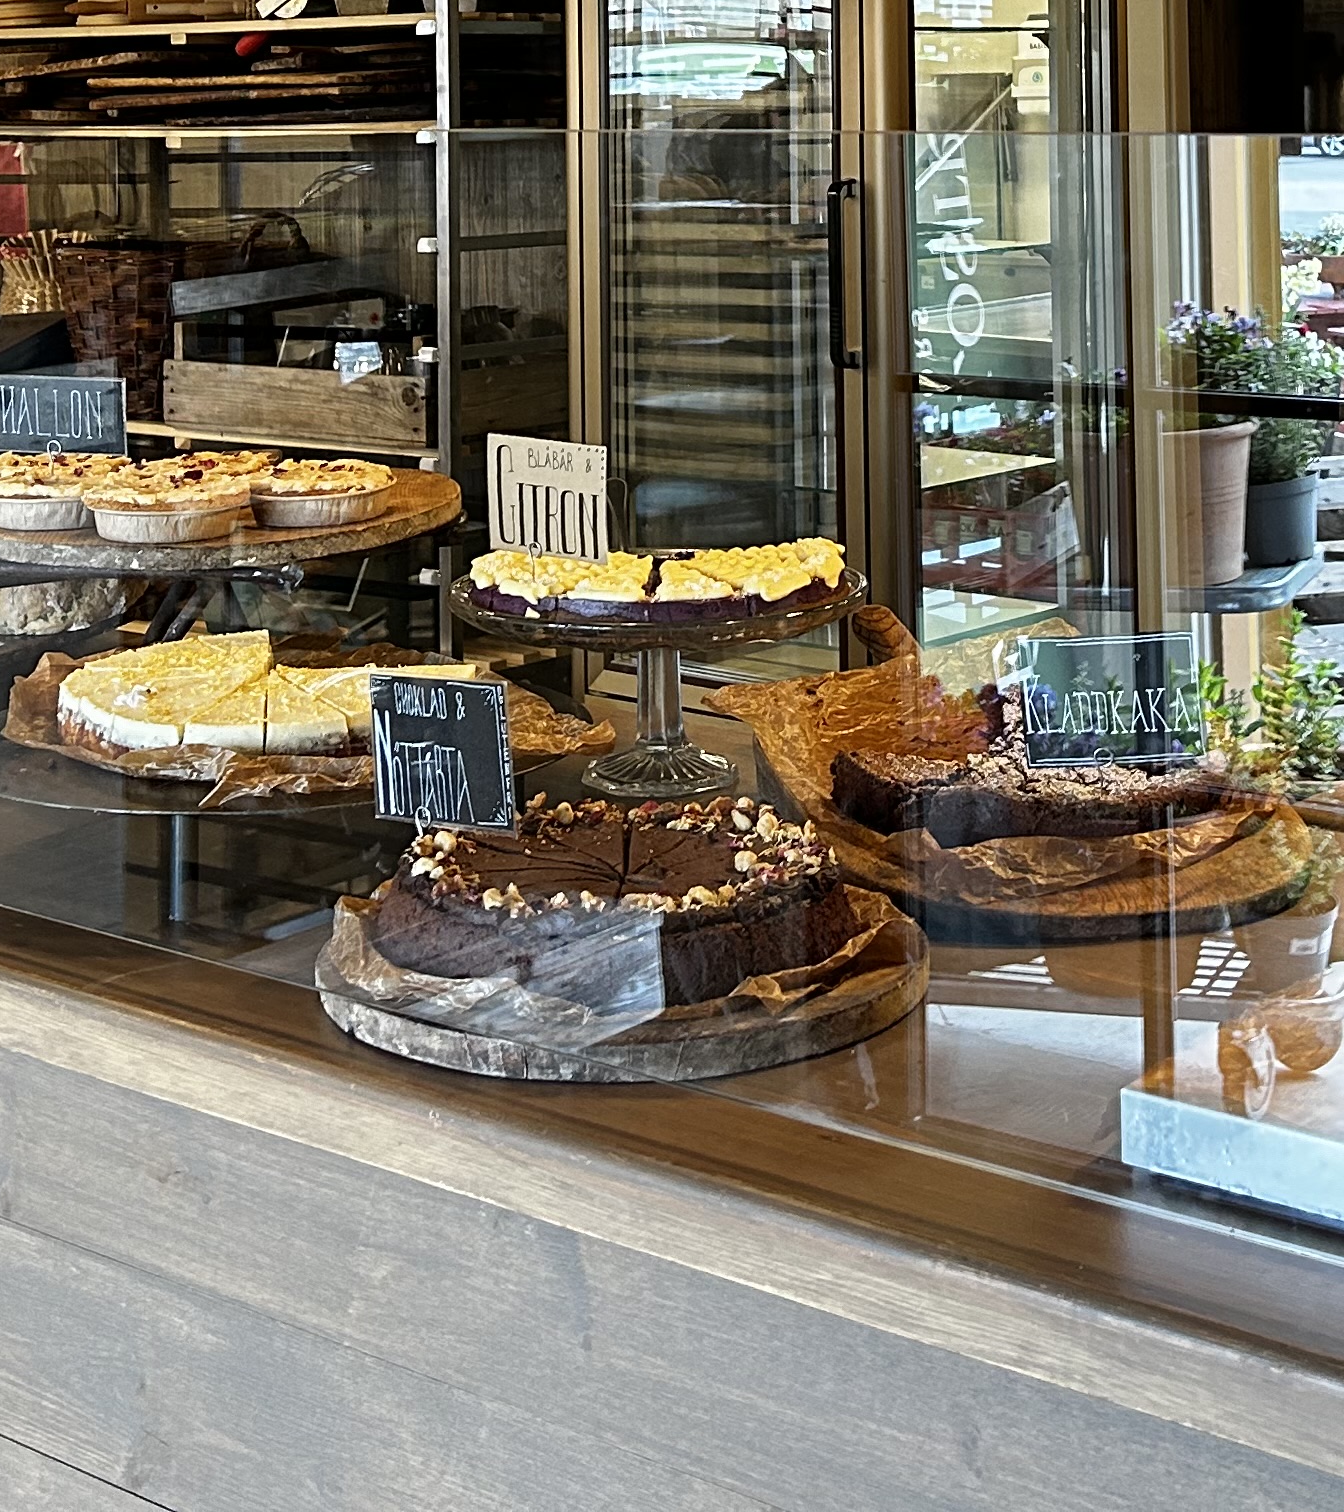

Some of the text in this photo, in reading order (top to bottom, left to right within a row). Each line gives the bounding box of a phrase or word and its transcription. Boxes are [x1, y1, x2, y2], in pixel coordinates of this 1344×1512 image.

[0, 384, 103, 439] HALLON
[585, 457, 592, 474] &
[496, 444, 599, 560] CITRON
[393, 681, 466, 721] CHOKLAD &
[1020, 674, 1201, 735] KLADDKAKA
